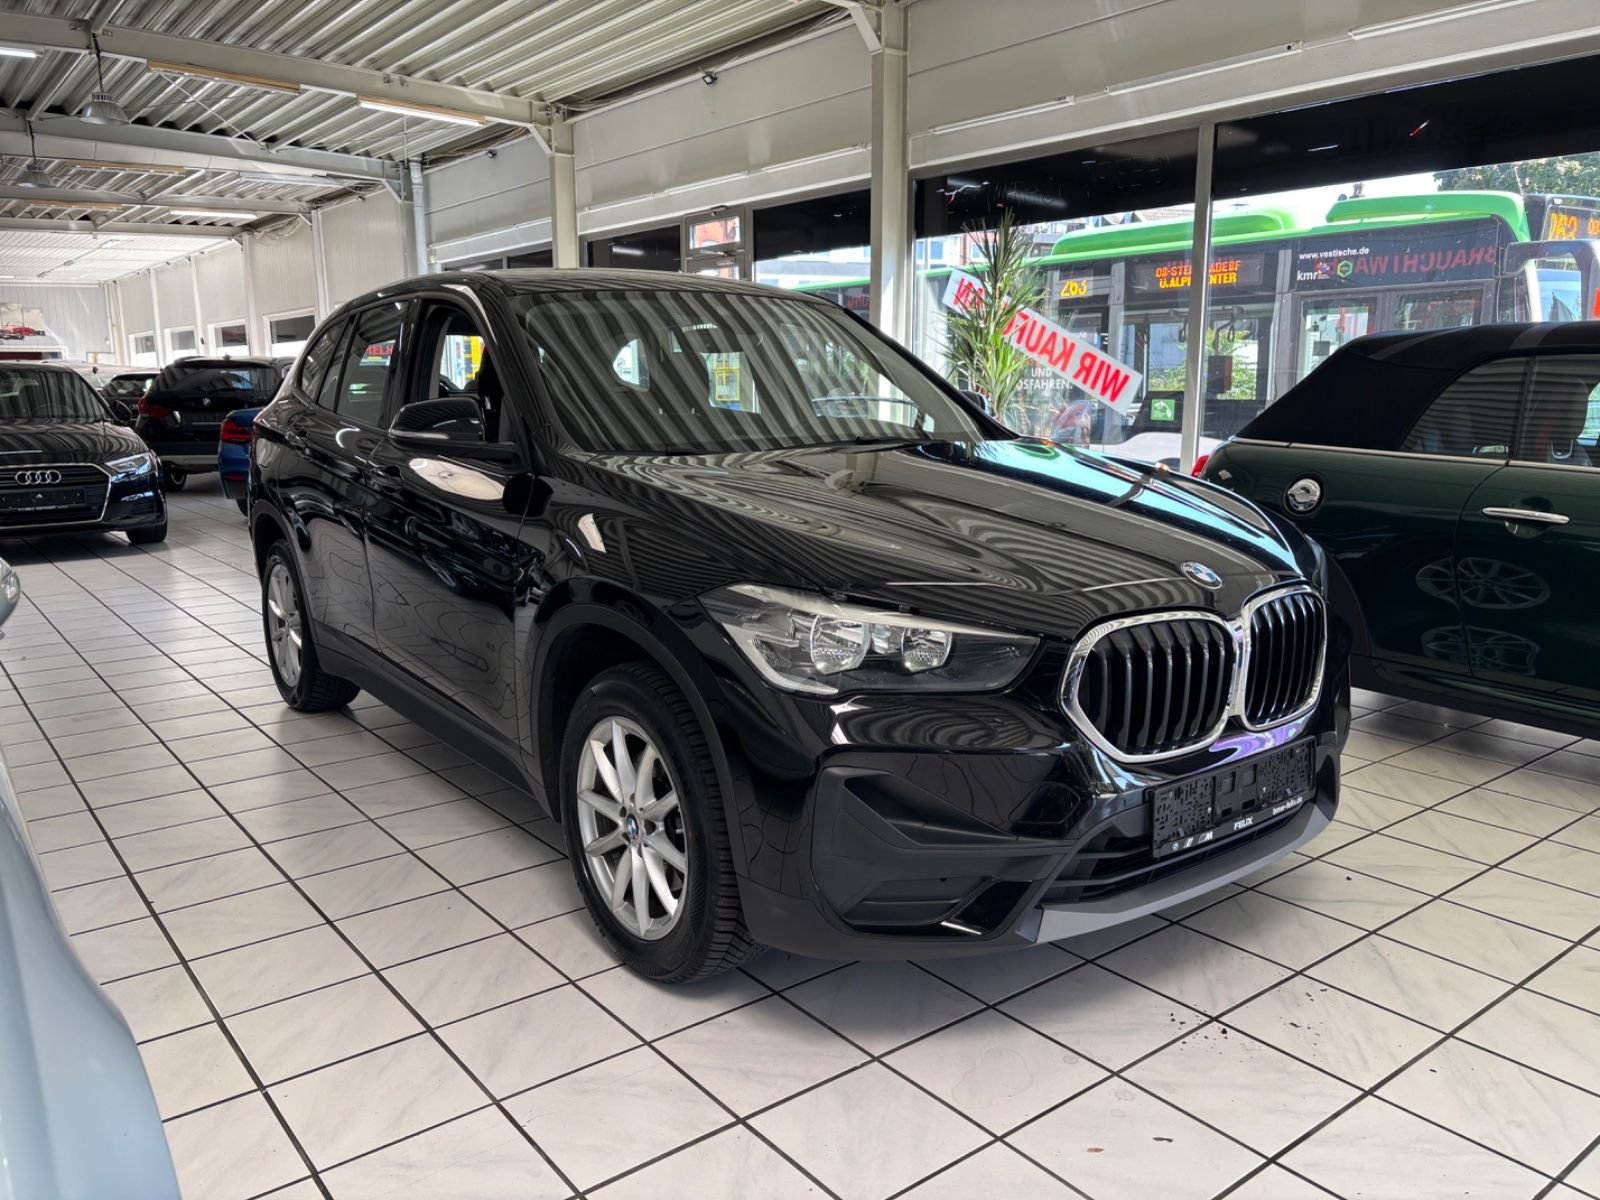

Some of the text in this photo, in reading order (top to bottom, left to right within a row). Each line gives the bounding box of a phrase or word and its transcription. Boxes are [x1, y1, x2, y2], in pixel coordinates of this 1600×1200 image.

[1061, 279, 1088, 297] 263
[1031, 367, 1052, 378] UND
[1014, 378, 1073, 391] OSFAHREN.
[1234, 816, 1253, 831] FELIX
